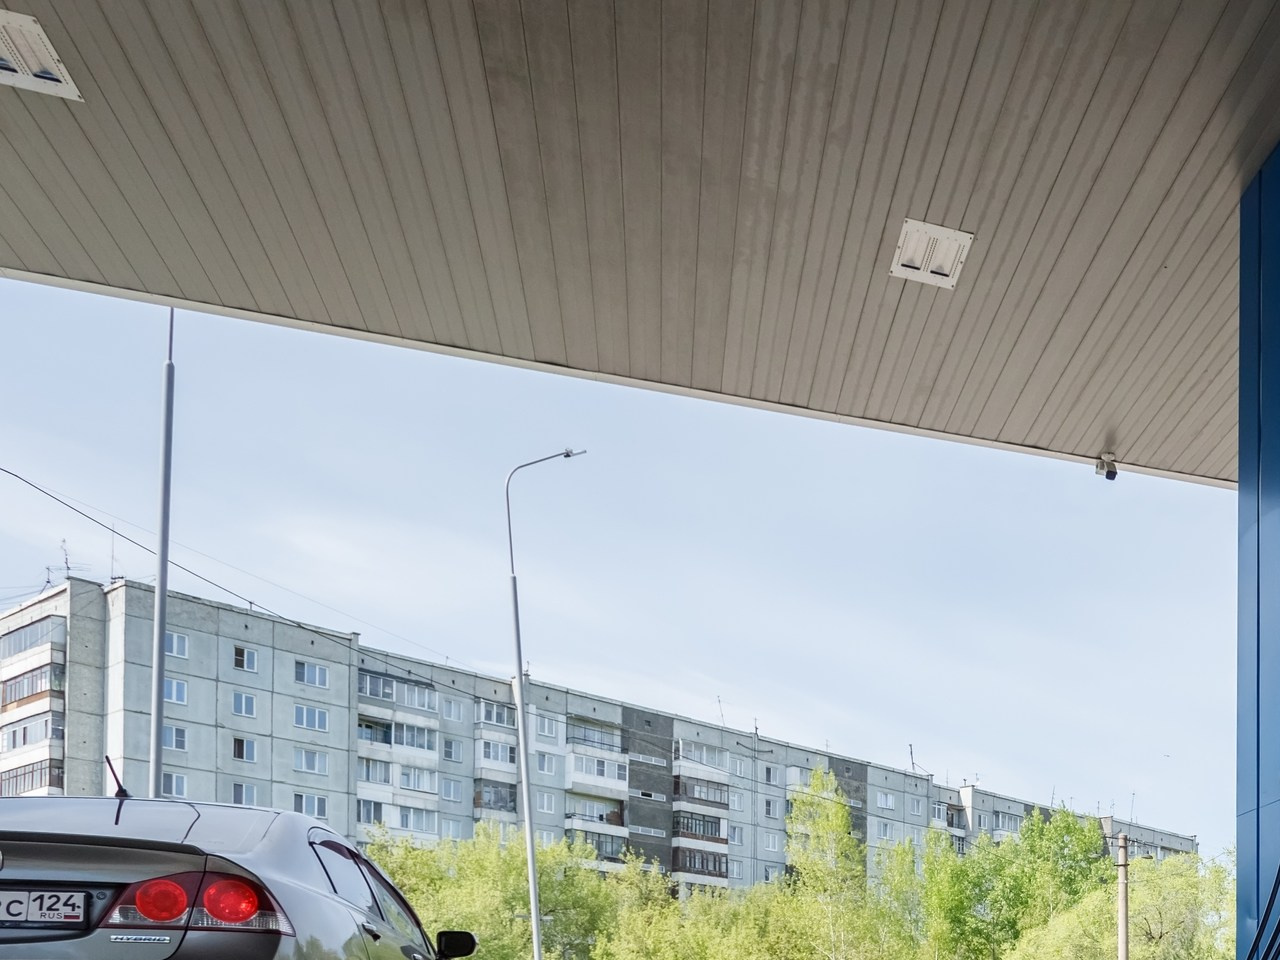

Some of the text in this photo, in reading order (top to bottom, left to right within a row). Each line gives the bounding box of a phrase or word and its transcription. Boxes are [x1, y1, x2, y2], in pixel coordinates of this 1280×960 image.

[32, 894, 77, 912] 124
[40, 912, 62, 920] RUS
[112, 935, 169, 943] HYBRID
